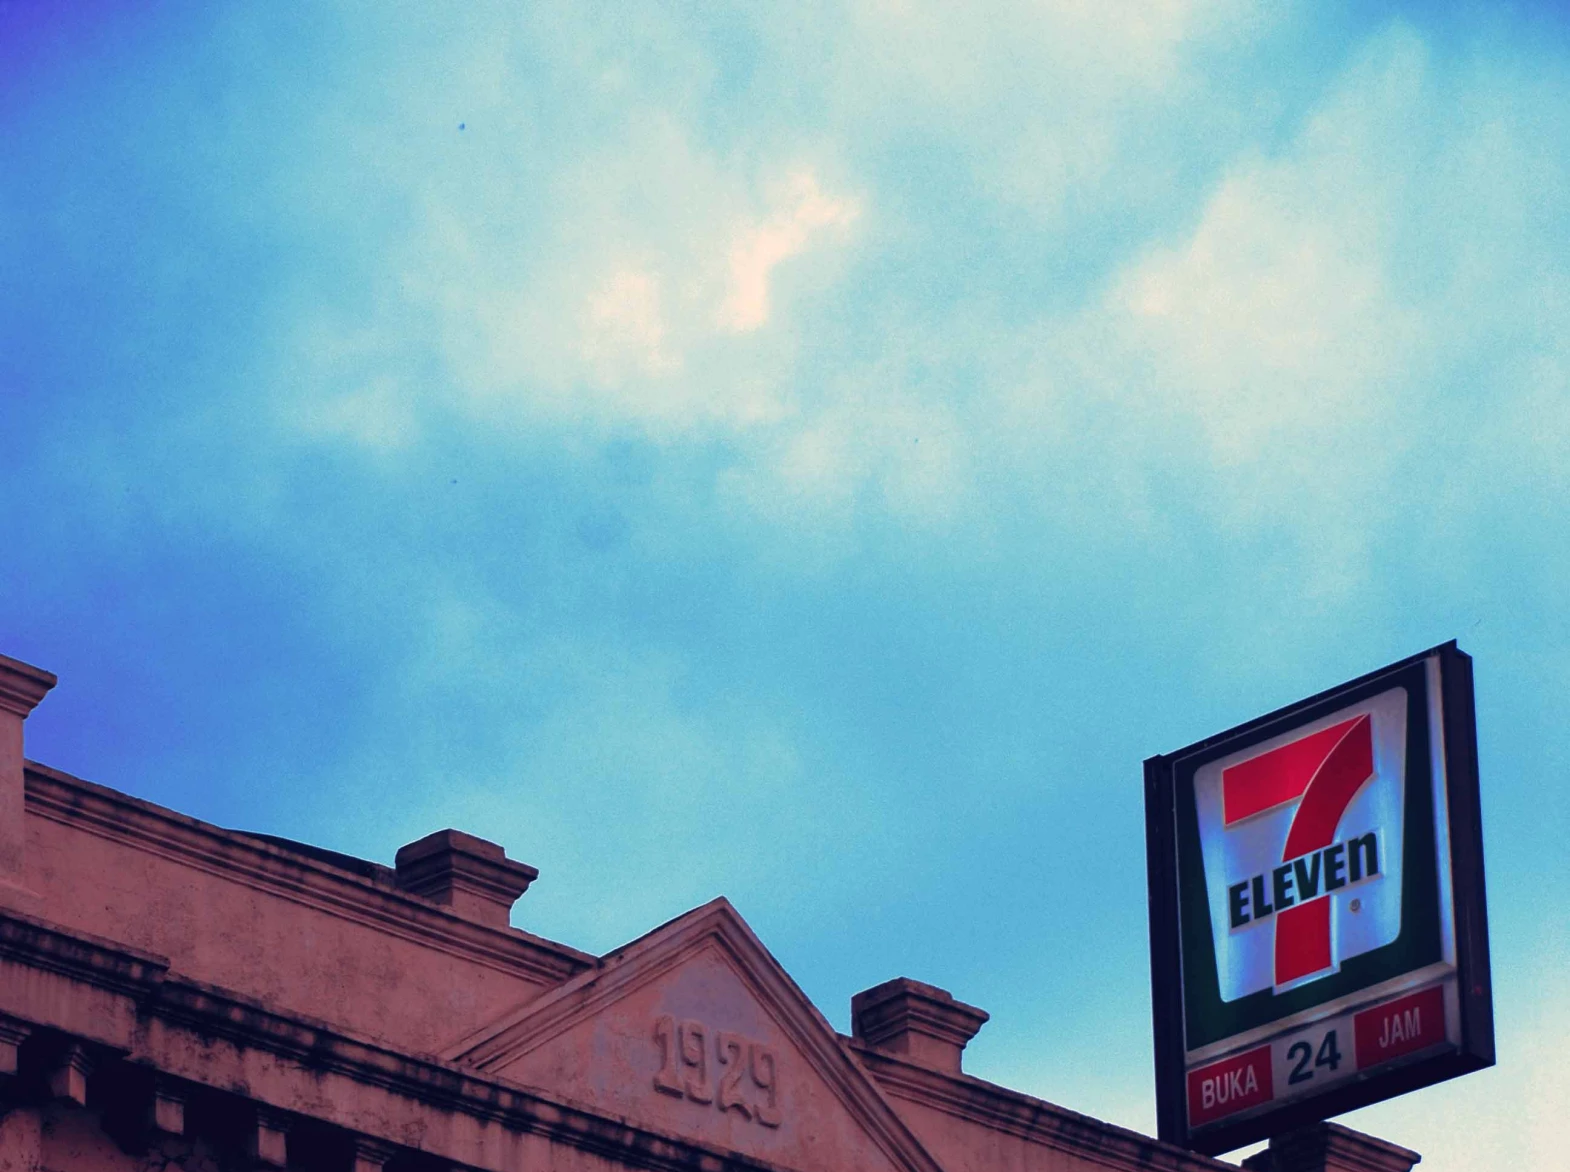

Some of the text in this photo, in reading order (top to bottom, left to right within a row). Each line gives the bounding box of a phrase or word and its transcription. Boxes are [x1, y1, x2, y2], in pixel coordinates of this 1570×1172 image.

[1222, 712, 1375, 988] 7
[1228, 830, 1379, 929] ELEVEn
[652, 1015, 782, 1130] 1929
[1201, 1006, 1422, 1110] BUKA 24 JAM
